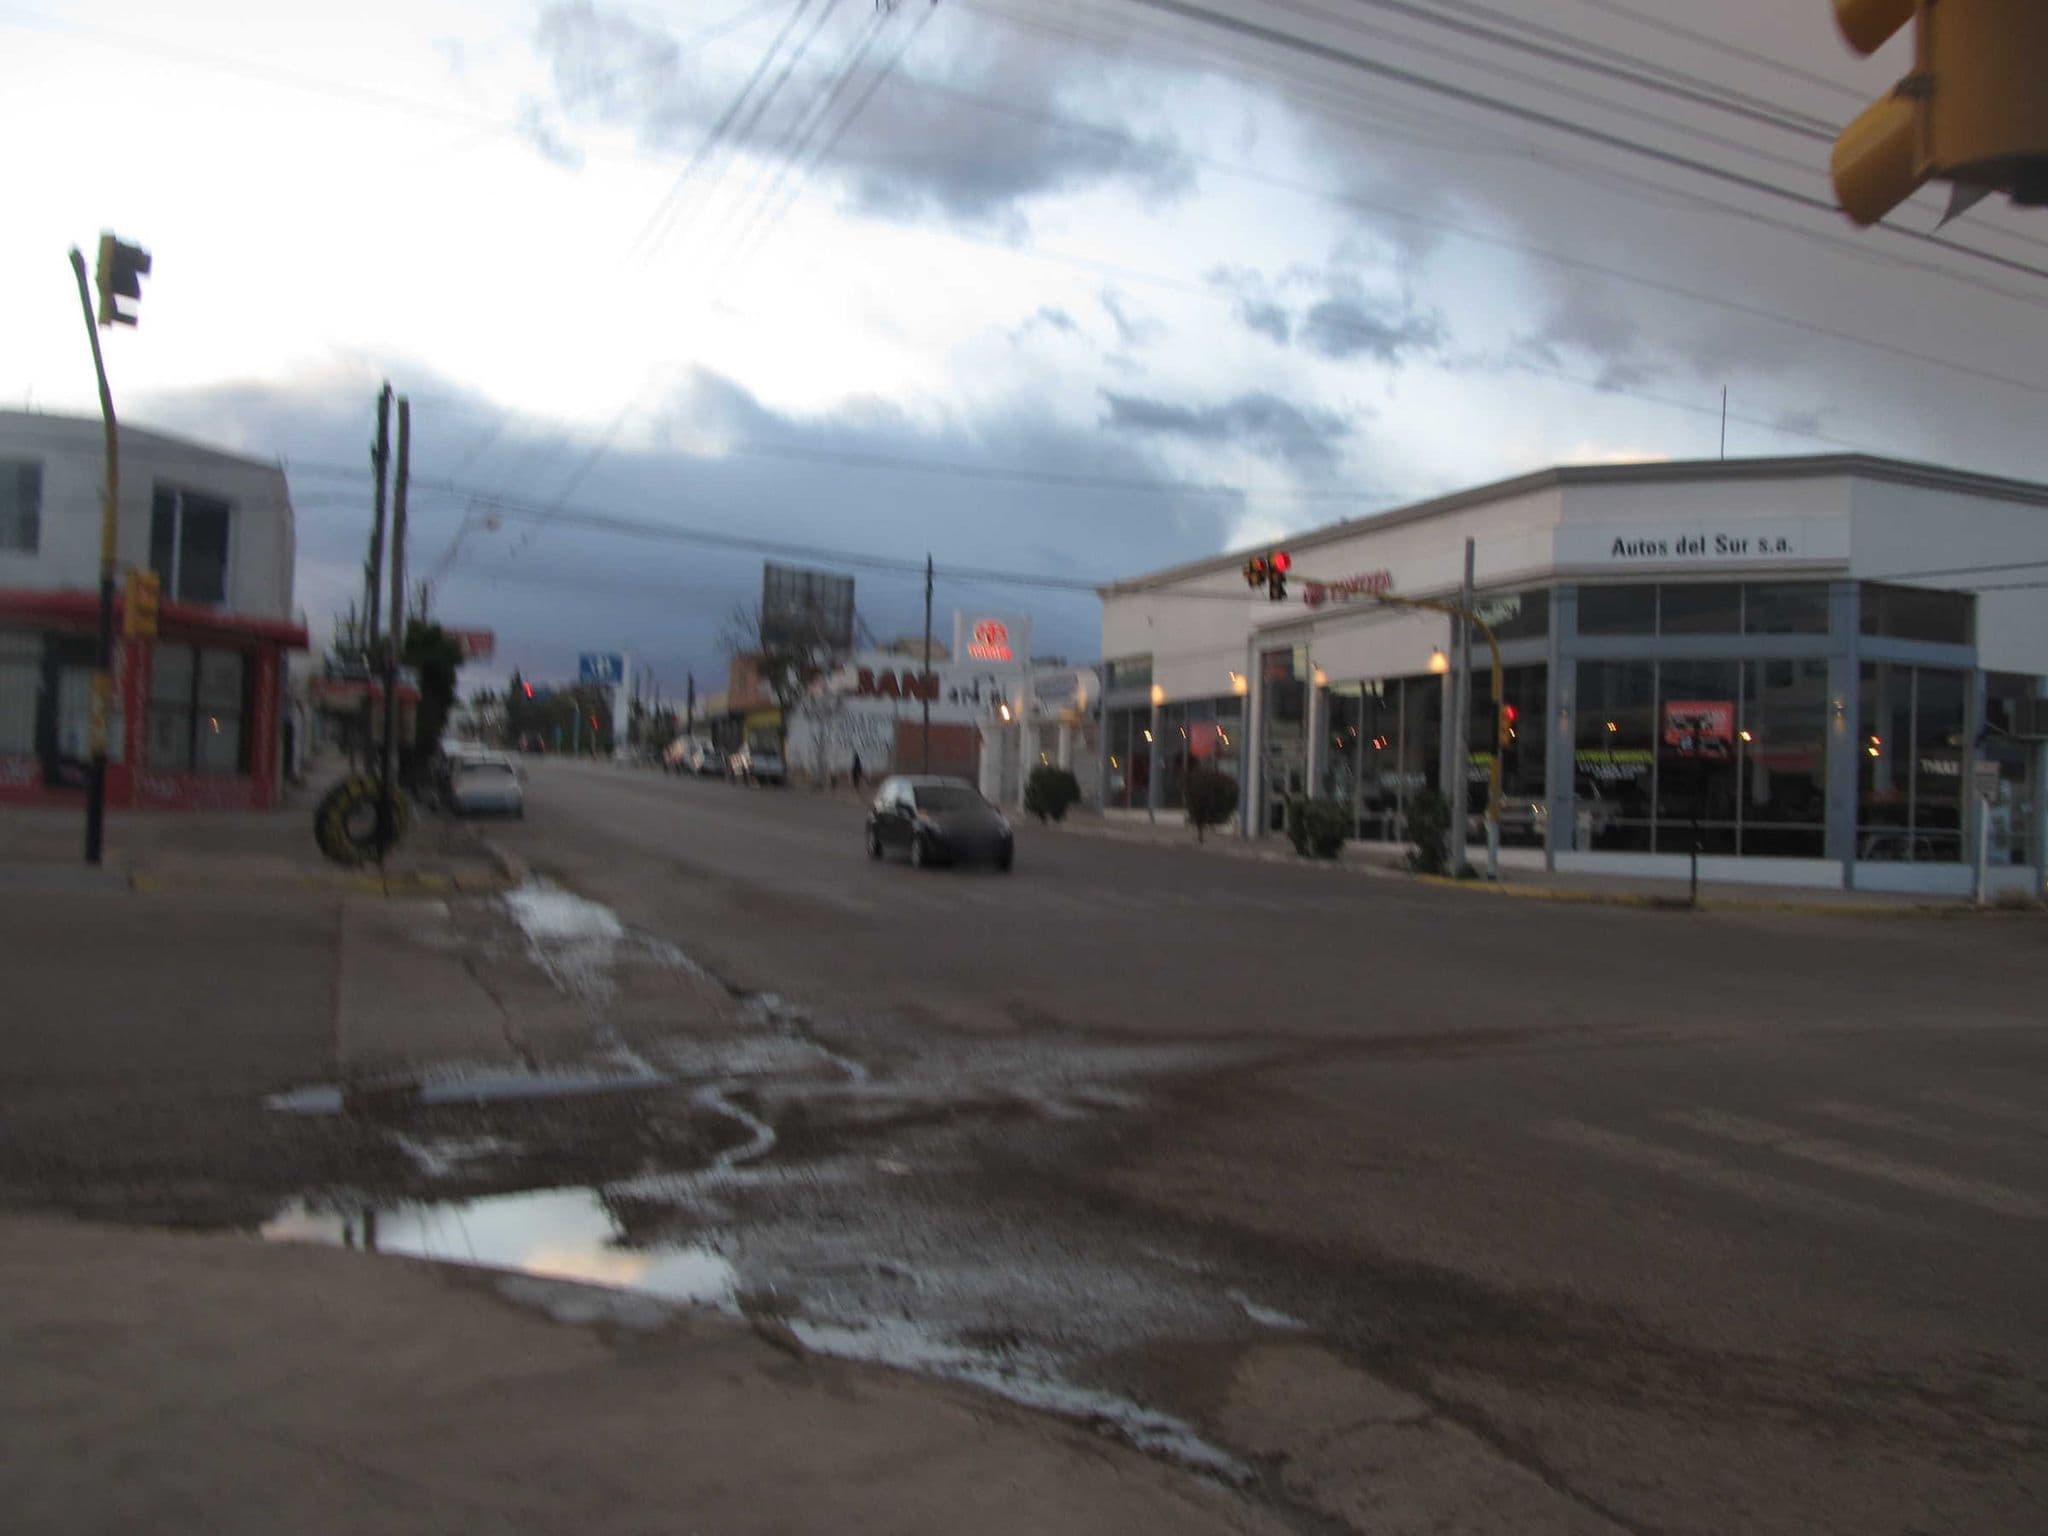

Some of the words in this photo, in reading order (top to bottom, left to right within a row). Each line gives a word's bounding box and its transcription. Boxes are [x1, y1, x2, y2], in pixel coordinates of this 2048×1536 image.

[1612, 536, 1669, 558] Autos
[1676, 534, 1706, 556] del
[1715, 533, 1749, 555] Sur
[1757, 535, 1794, 554] s.a.
